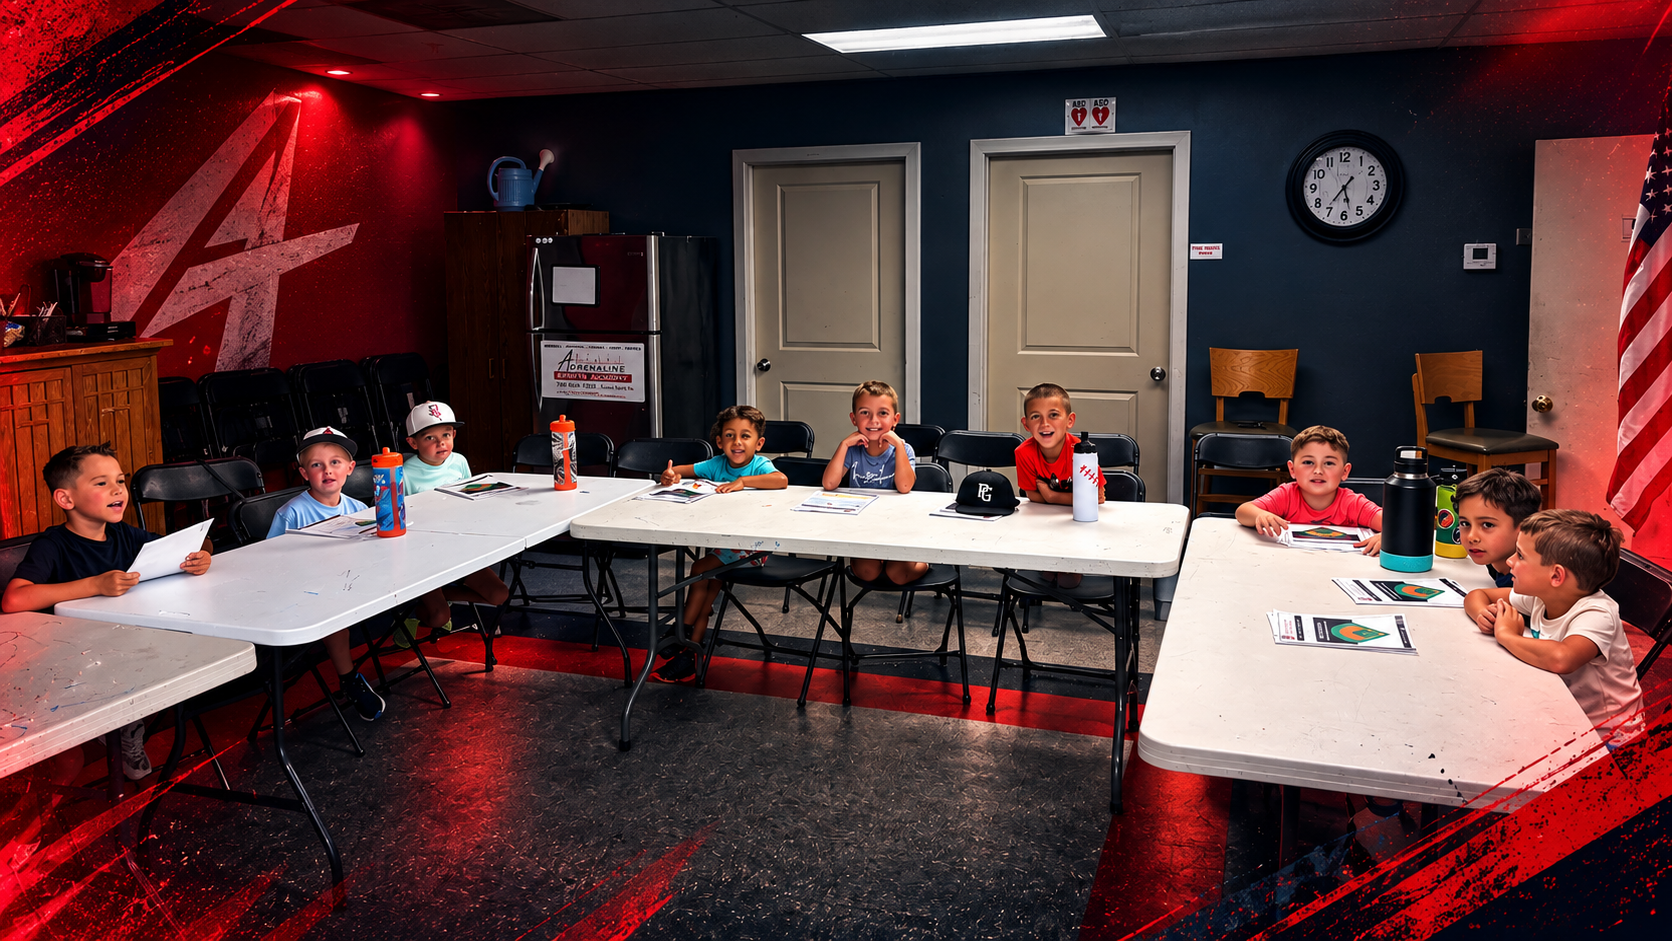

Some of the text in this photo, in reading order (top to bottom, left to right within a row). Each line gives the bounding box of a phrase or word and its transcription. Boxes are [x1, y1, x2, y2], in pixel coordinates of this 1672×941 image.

[1326, 156, 1334, 168] 11
[1339, 151, 1351, 163] 12
[1359, 155, 1363, 167] 1
[1313, 169, 1325, 180] 10
[1367, 165, 1375, 176] 2
[1309, 183, 1317, 194] 9
[1372, 180, 1380, 191] 3
[1314, 197, 1322, 208] 8
[1366, 194, 1375, 205] 4
[1326, 206, 1333, 218] 7
[1340, 210, 1348, 221] 6
[1355, 205, 1363, 216] 5
[557, 348, 626, 373] ADRENALINE
[977, 482, 993, 502] PG
